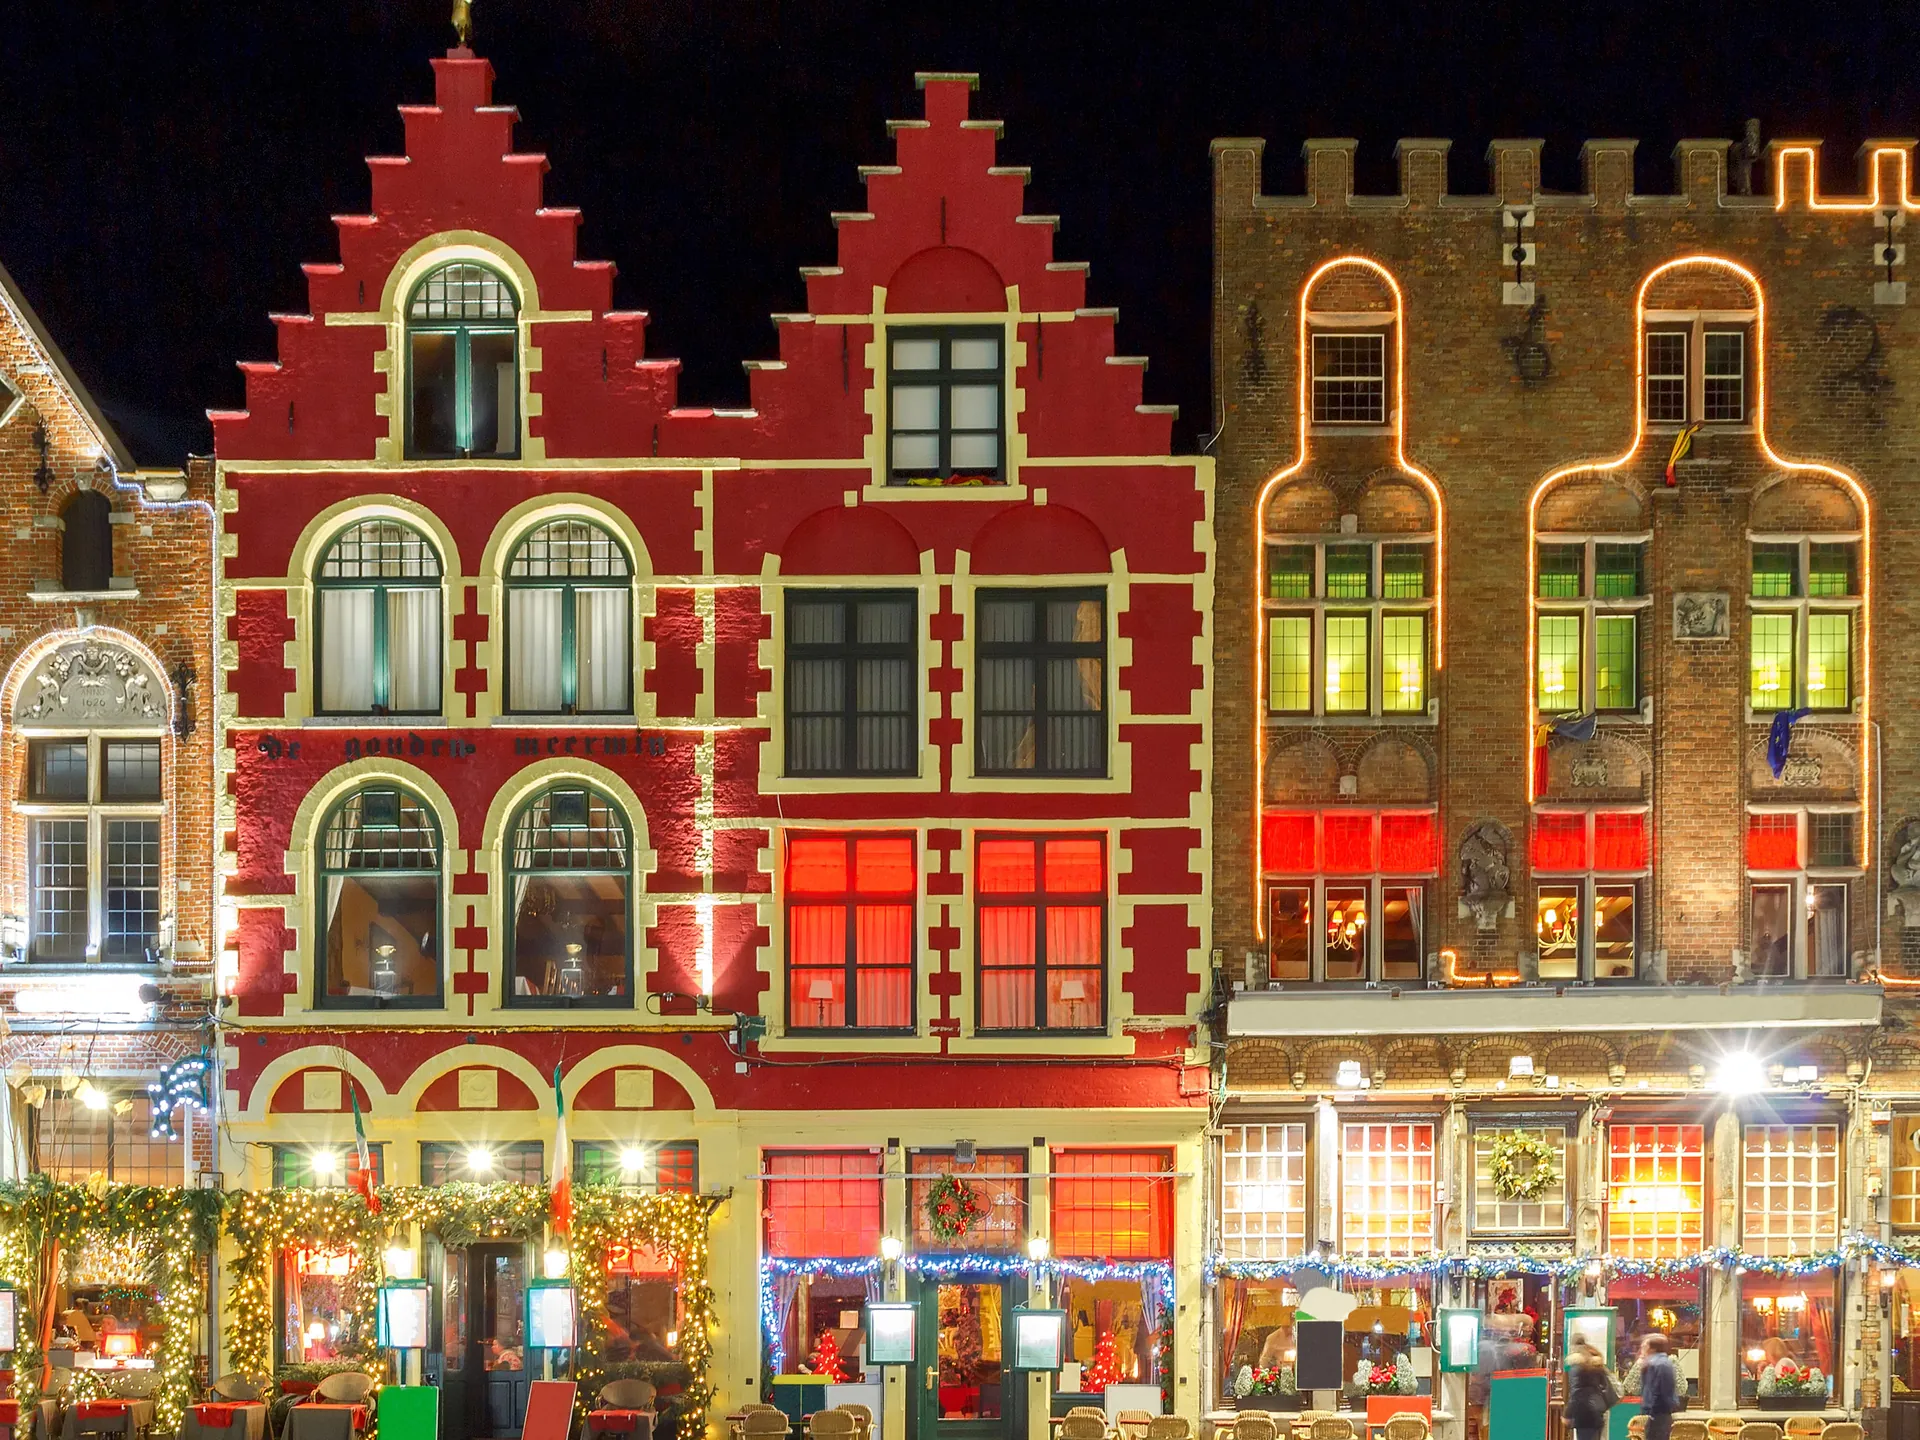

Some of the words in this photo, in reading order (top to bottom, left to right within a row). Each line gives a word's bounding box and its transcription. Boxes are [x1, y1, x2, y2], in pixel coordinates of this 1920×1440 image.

[82, 698, 106, 707] 1626
[265, 733, 301, 760] de
[344, 731, 466, 763] gouden
[514, 734, 666, 756] meermin
